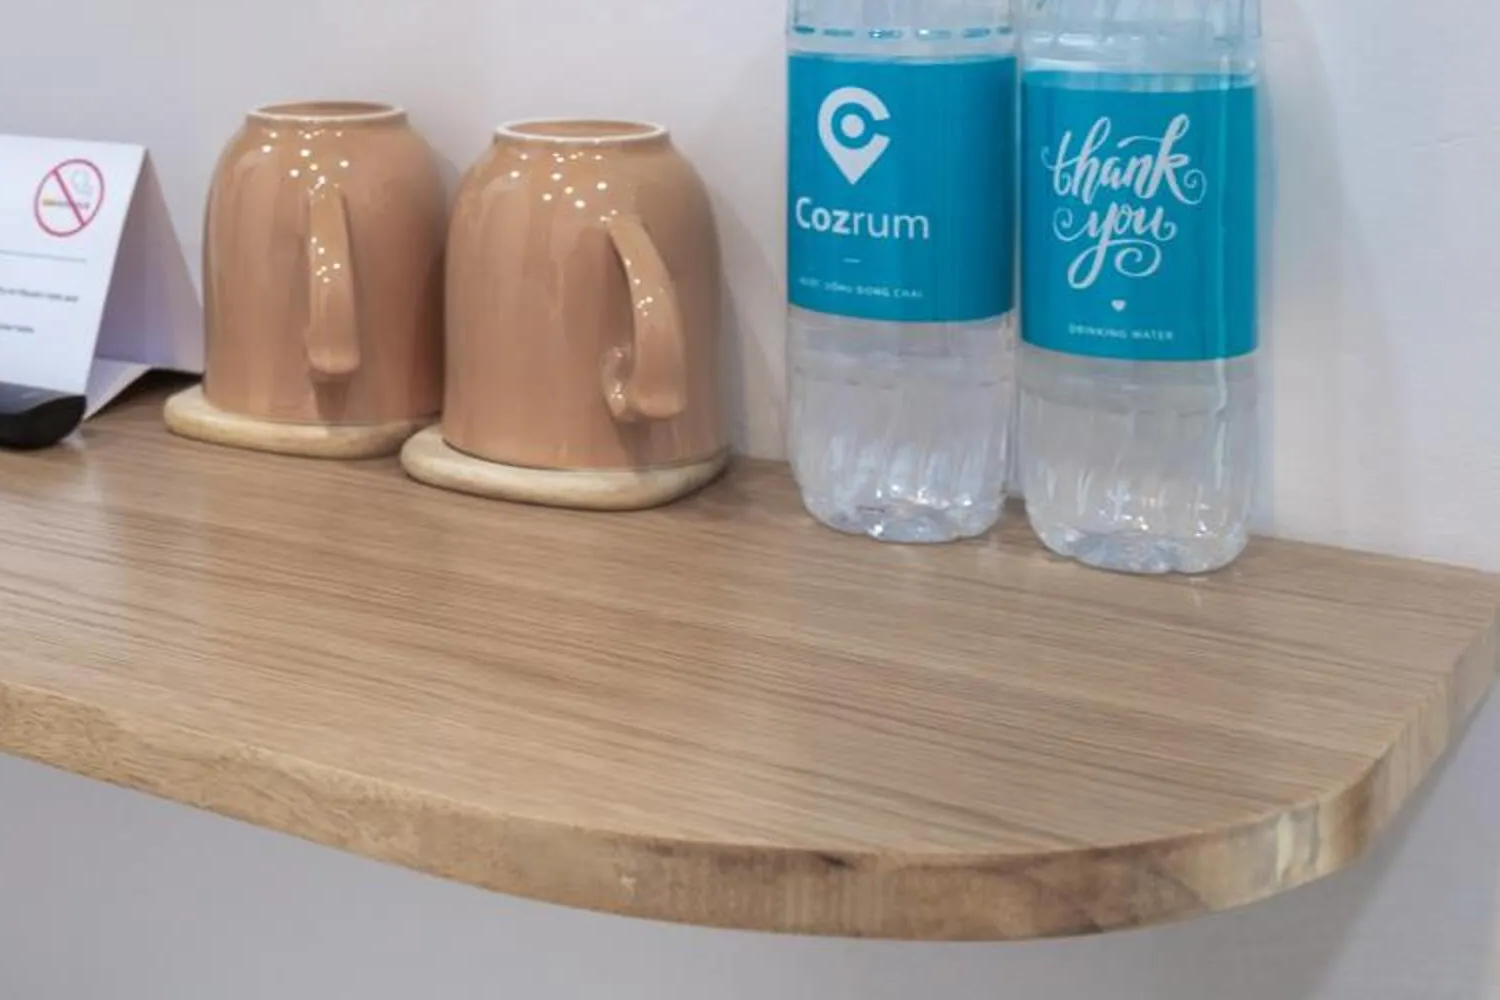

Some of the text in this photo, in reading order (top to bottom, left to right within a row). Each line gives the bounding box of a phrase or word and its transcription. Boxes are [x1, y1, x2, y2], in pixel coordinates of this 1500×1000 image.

[1041, 113, 1206, 204] thank
[796, 197, 930, 240] Cozrum
[1053, 202, 1177, 289] you
[1067, 323, 1174, 341] DRINKING WATER
